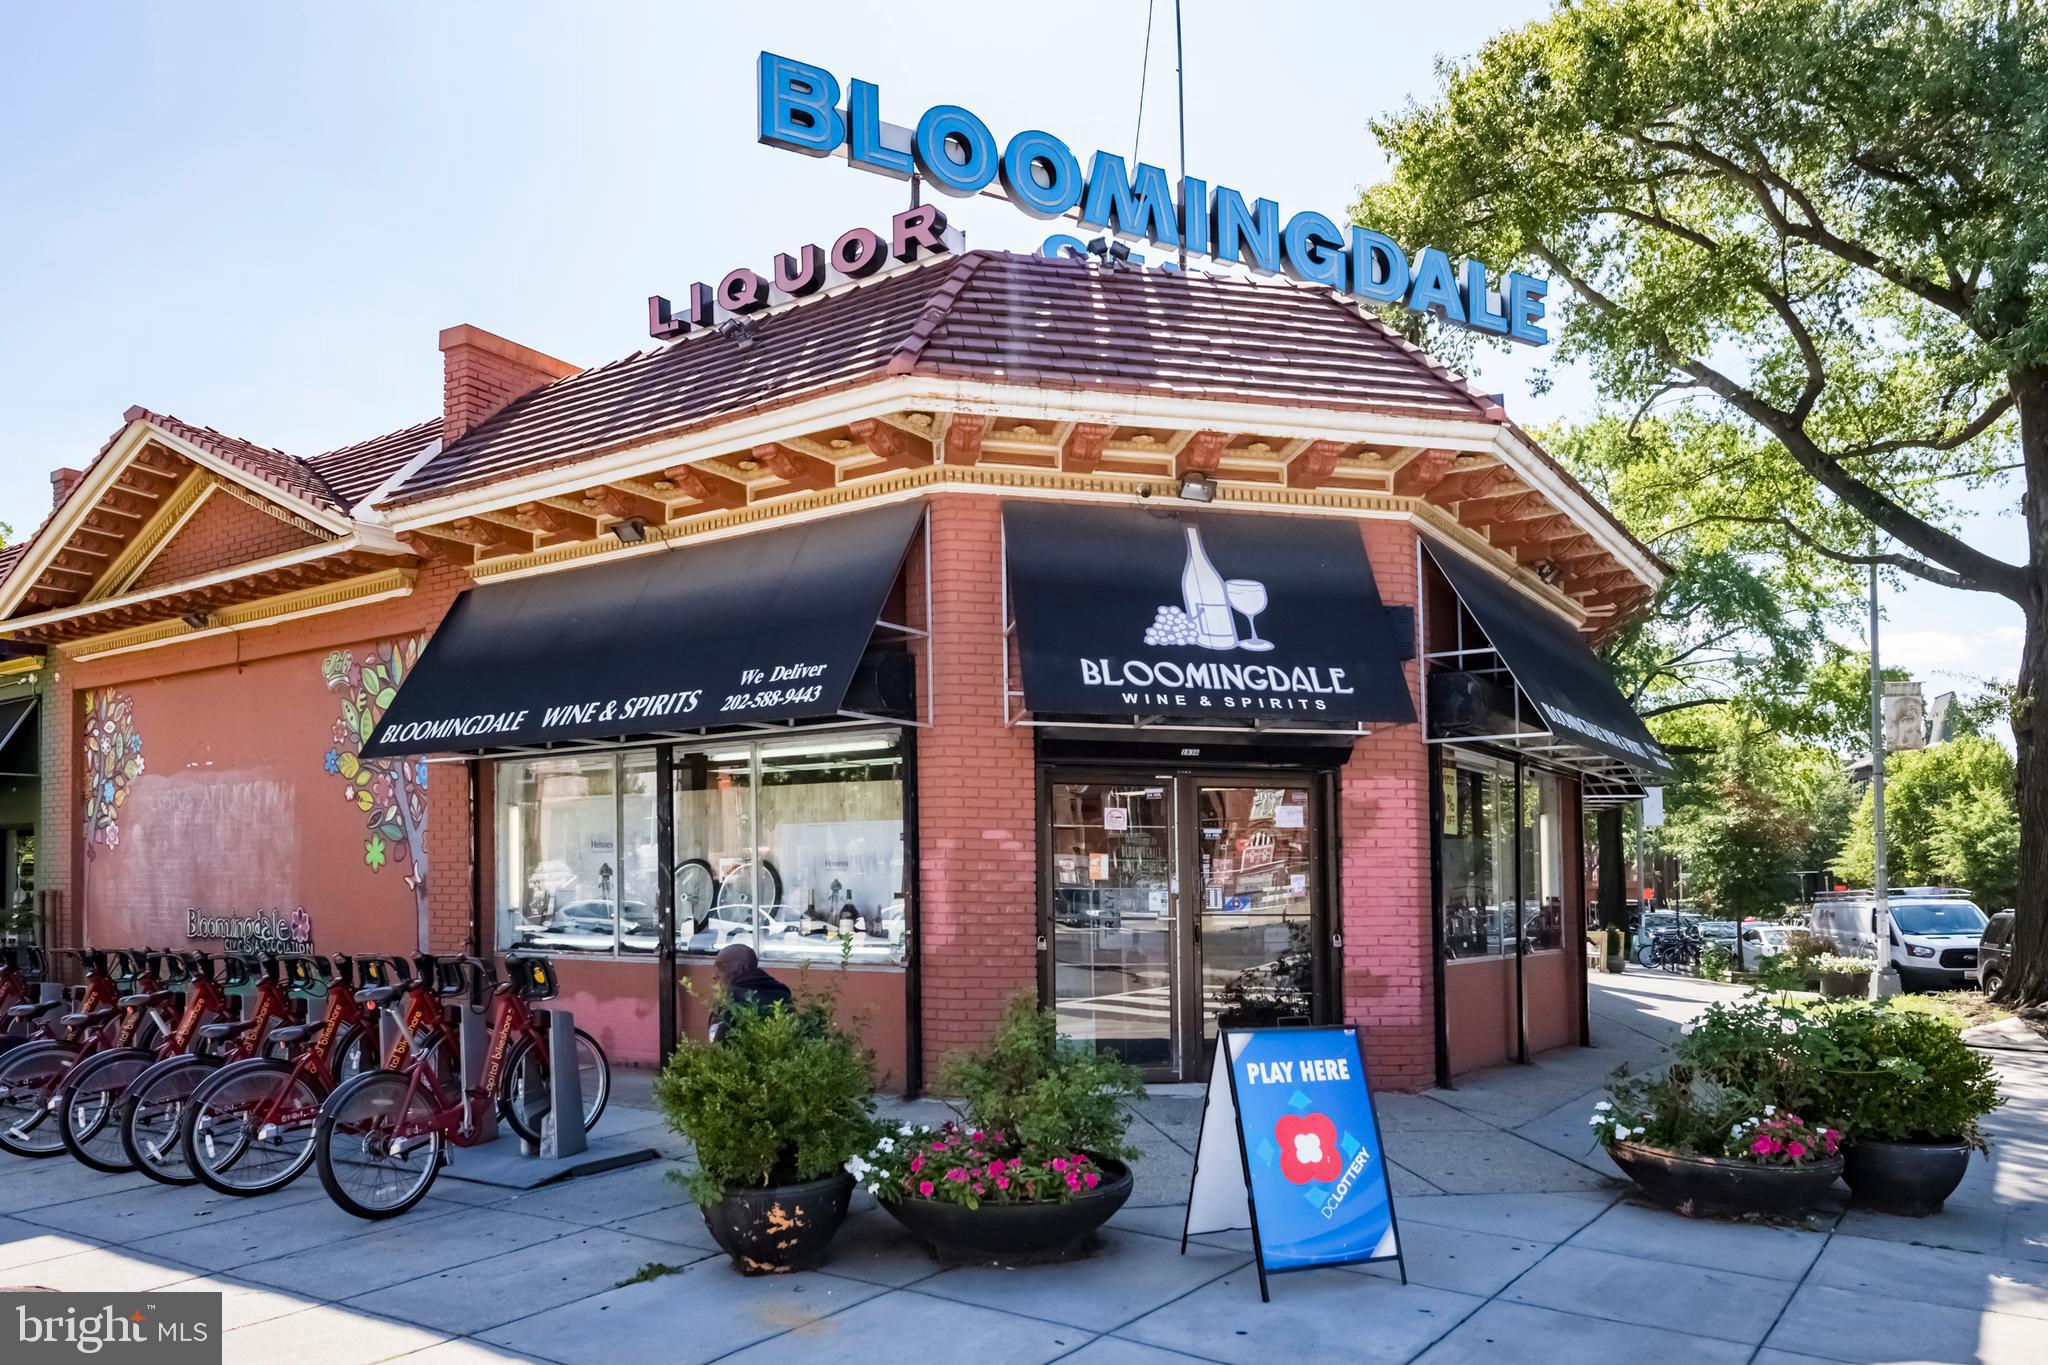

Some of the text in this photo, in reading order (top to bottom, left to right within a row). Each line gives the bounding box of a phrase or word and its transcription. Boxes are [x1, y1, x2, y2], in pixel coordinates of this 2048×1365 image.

[757, 50, 1548, 347] BLOOMINGDALE
[648, 203, 948, 340] LIQUOR
[740, 661, 828, 687] We Deliver
[1080, 658, 1354, 694] BLOOMINGDALE
[379, 689, 703, 745] BLOOMINGDALE WINE & SPIRITS
[720, 684, 823, 713] 202-588-9443
[1121, 692, 1328, 711] WINE & SPIRITS
[186, 906, 292, 954] Bloomingdale
[254, 939, 314, 956] ASSOCIATION
[320, 1003, 342, 1046] bikeshare
[393, 1010, 422, 1054] bikhare
[491, 1015, 513, 1060] bikeshare
[1246, 1058, 1350, 1085] PLAY HERE
